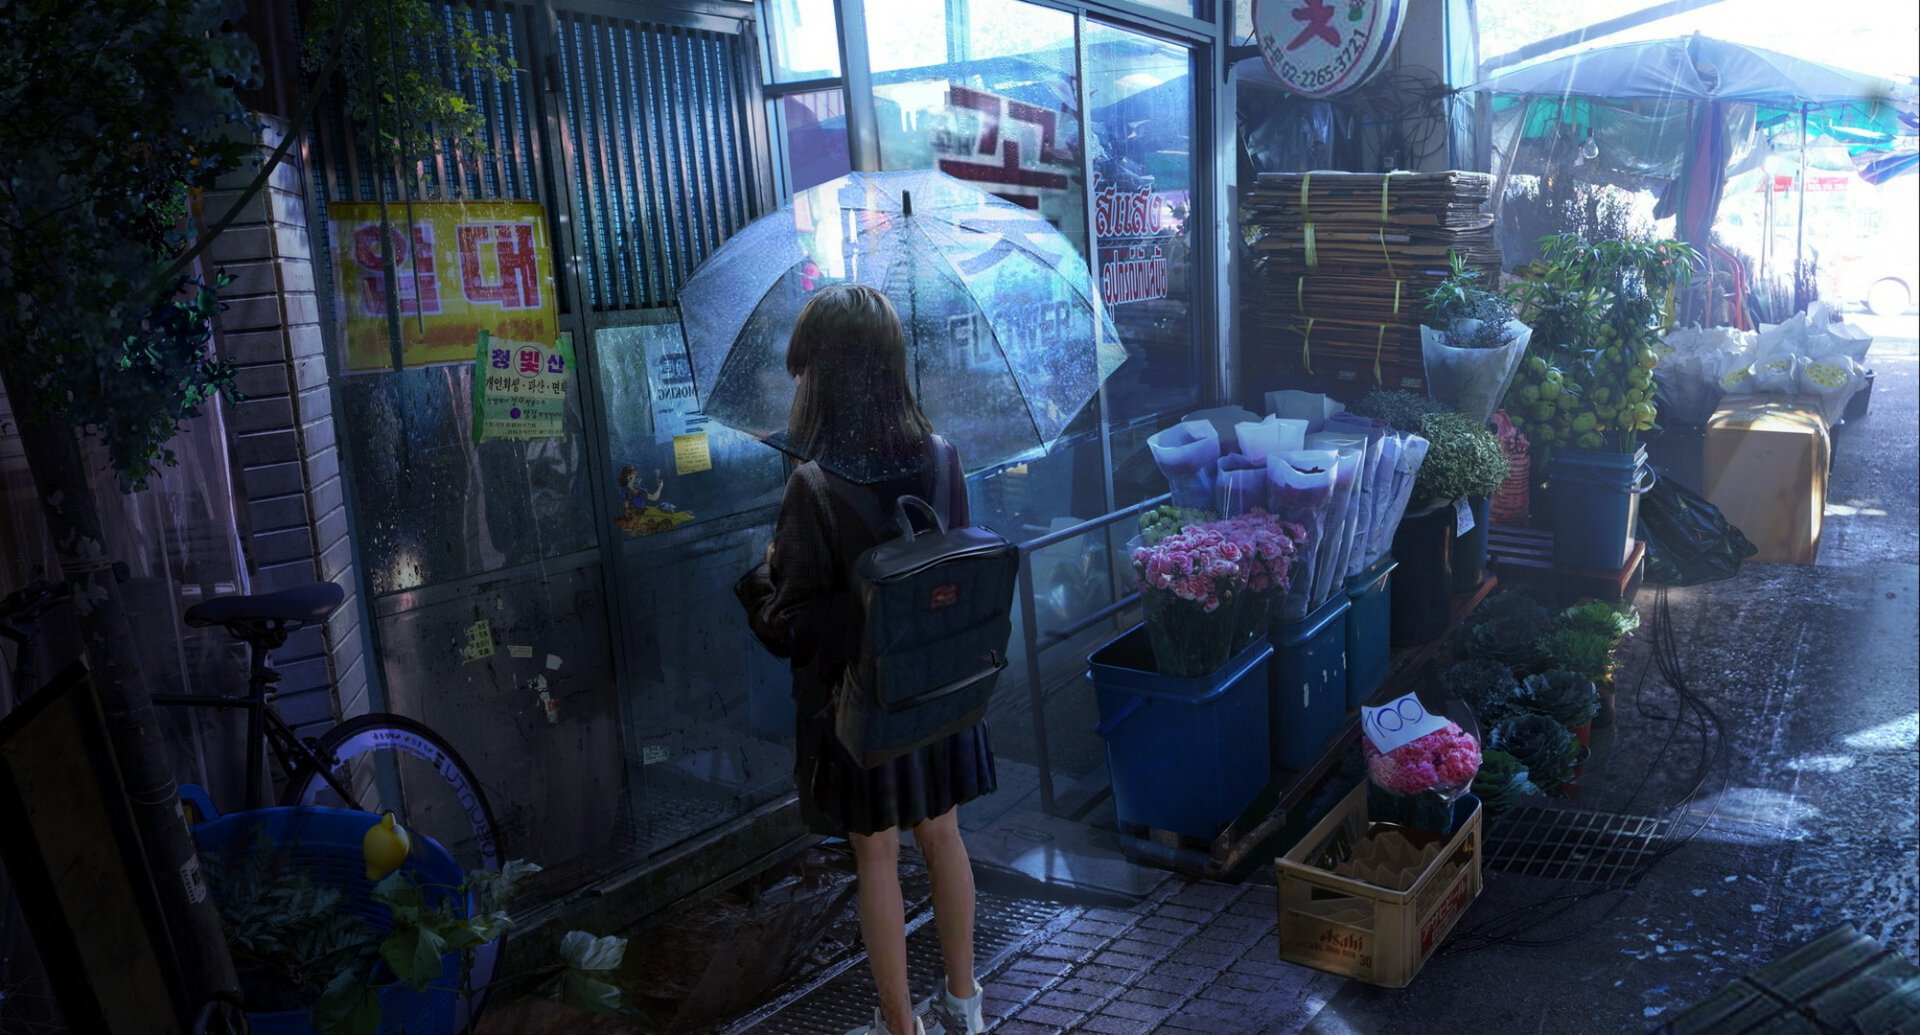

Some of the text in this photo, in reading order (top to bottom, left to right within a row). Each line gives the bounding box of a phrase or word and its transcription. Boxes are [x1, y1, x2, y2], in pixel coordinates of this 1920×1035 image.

[949, 301, 1071, 363] FLOWER
[1365, 698, 1423, 738] 100
[1320, 929, 1363, 952] Asahi
[1359, 954, 1372, 969] 30
